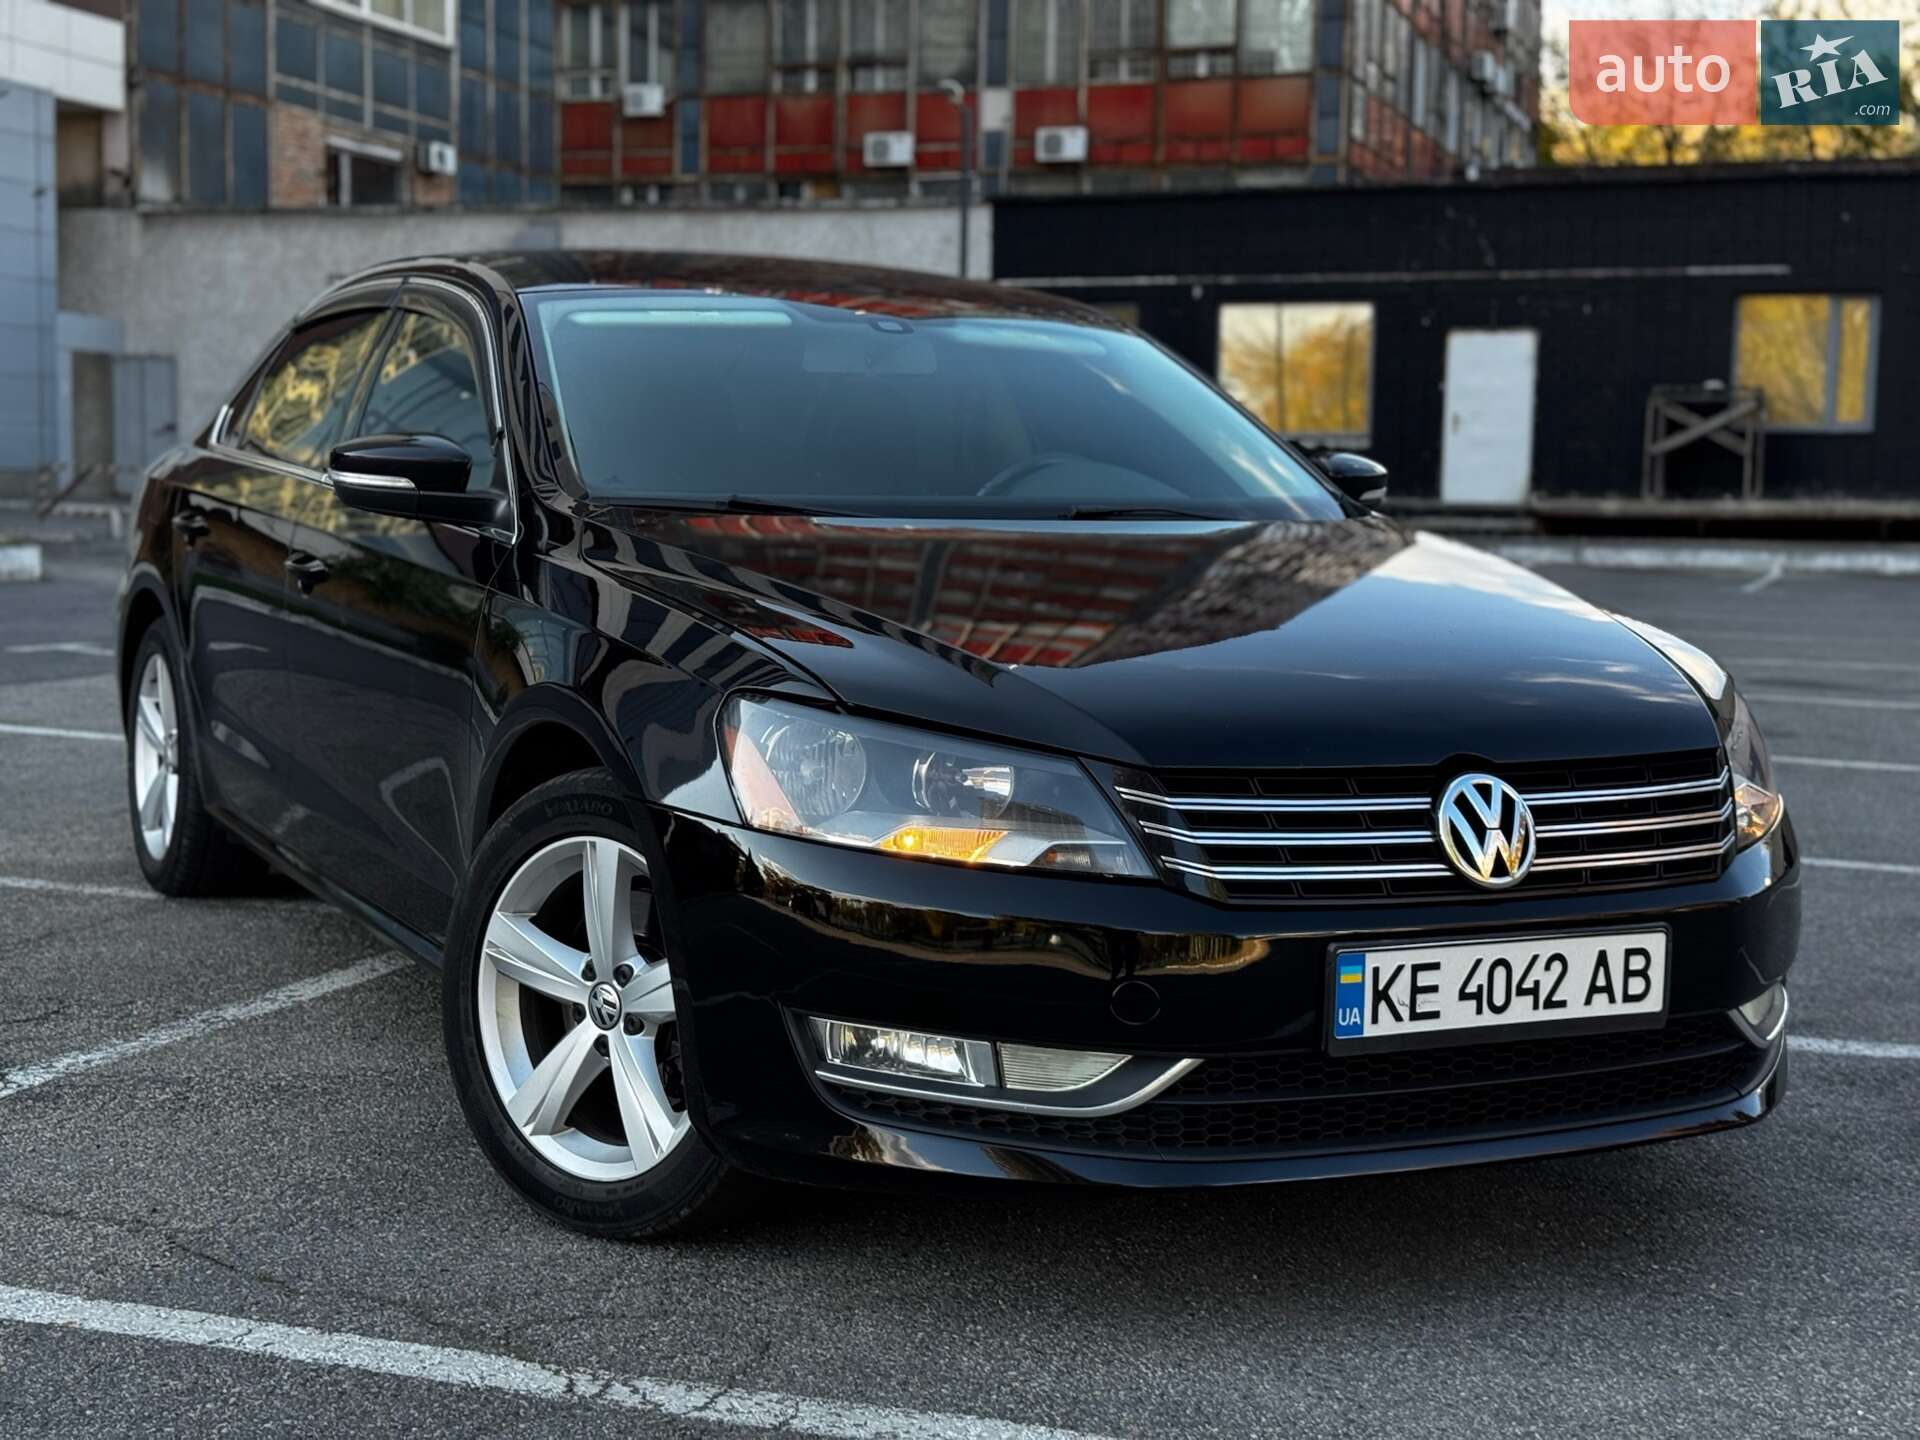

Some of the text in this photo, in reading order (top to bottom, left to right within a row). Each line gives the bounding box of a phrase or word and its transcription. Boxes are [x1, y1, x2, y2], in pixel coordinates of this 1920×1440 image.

[1371, 947, 1652, 1025] KE 4042 AB
[1338, 1007, 1361, 1026] UA
